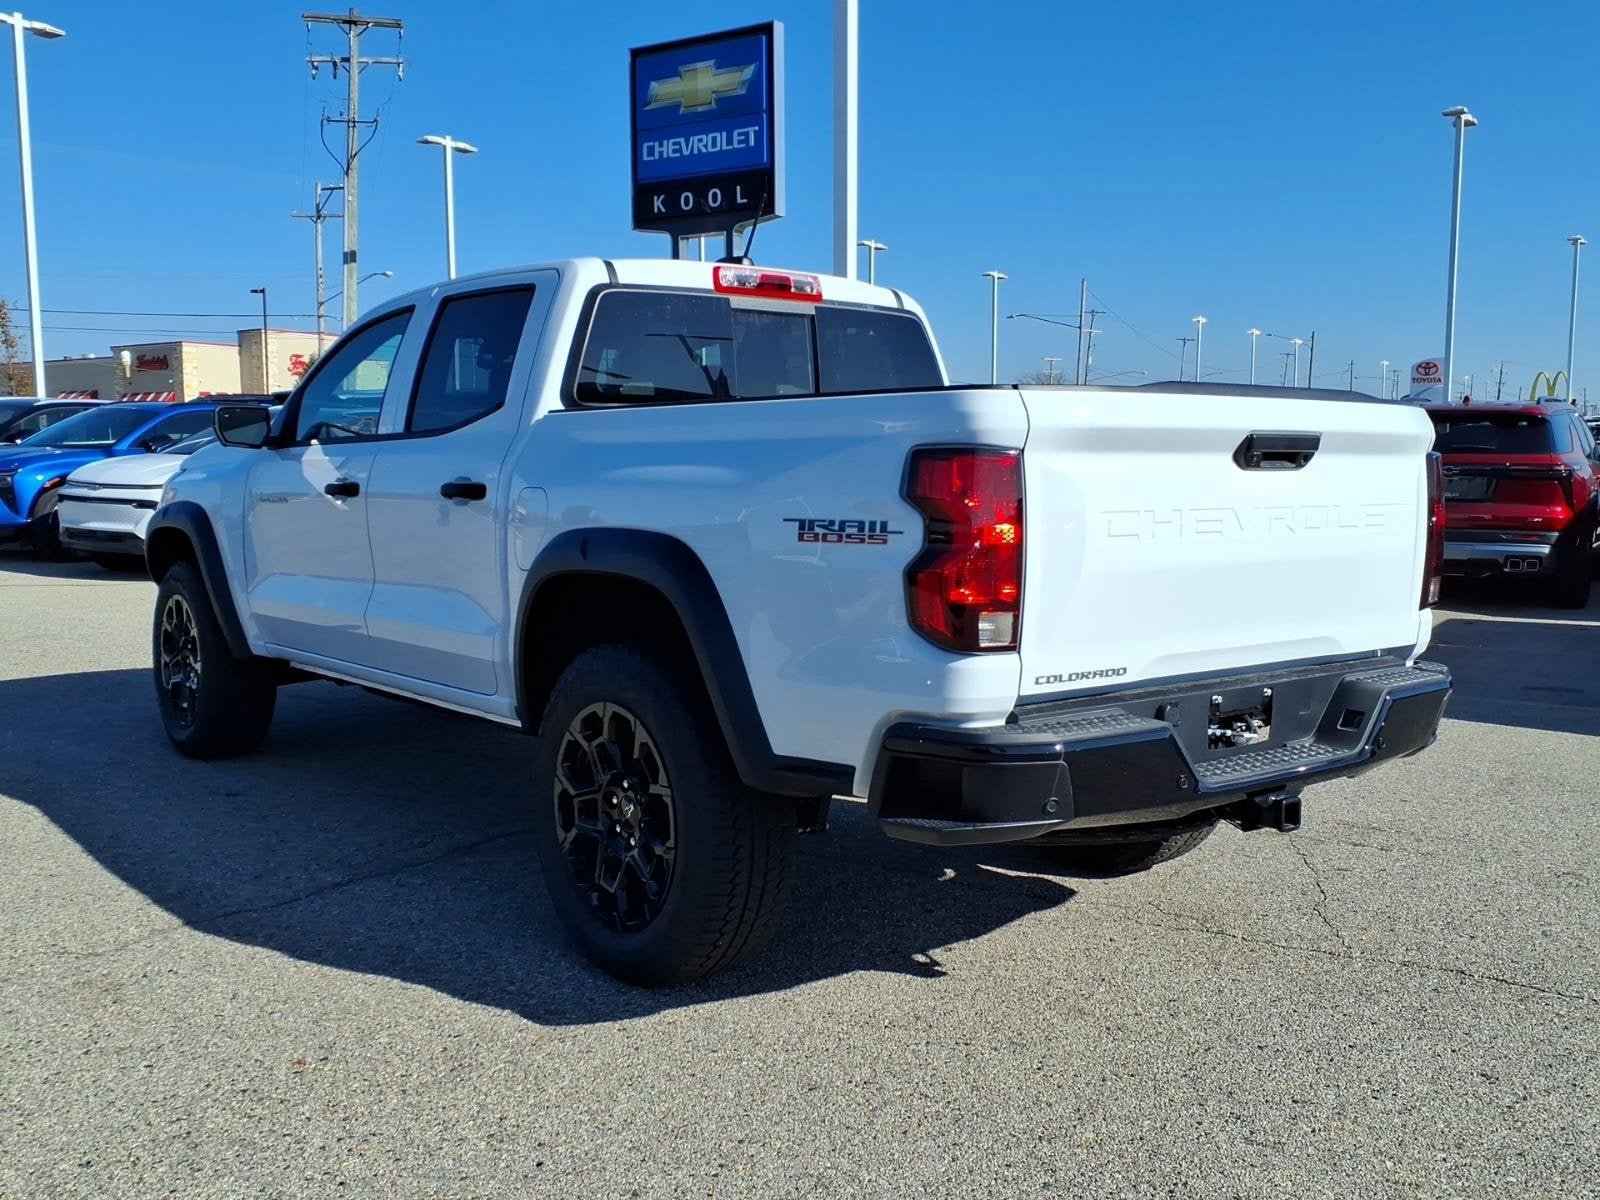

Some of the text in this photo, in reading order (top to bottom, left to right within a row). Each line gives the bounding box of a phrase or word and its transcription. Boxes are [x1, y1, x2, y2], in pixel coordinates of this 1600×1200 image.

[642, 126, 759, 161] CHEVROLET
[653, 185, 748, 213] KOOL
[1411, 377, 1442, 385] TOYOTA
[782, 518, 904, 535] TRAIL
[797, 532, 889, 545] BOSS
[1034, 667, 1128, 686] COLORADO
